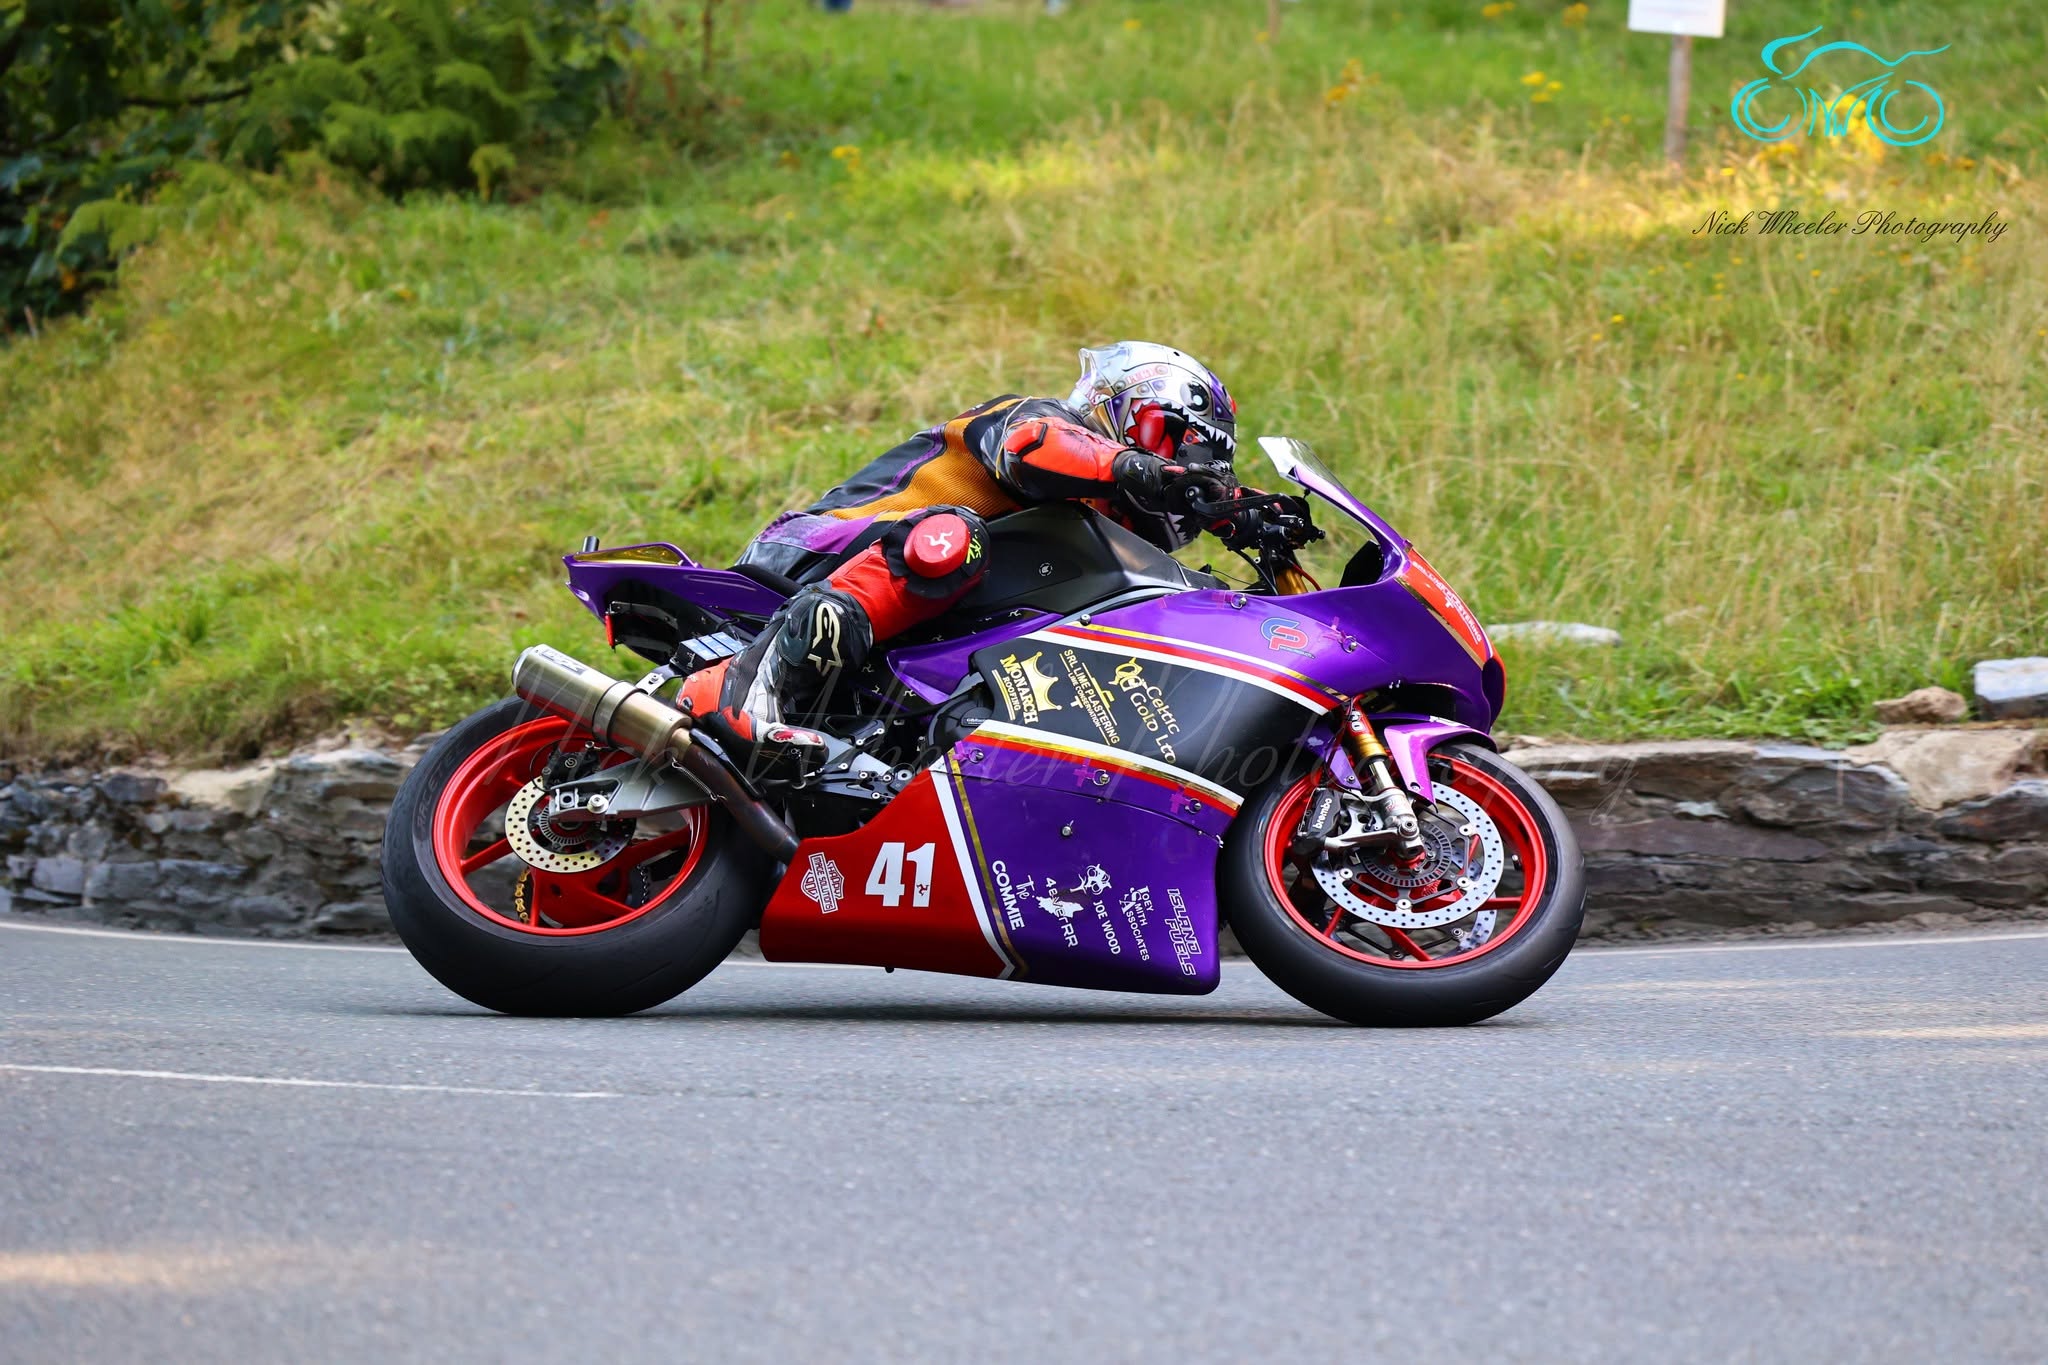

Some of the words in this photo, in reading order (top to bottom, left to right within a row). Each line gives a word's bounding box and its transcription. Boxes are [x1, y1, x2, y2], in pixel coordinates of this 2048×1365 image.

[1000, 653, 1039, 724] MONARCH
[1003, 676, 1021, 711] ROOFING
[1064, 649, 1078, 668] SRL
[1073, 667, 1091, 690] LIME
[1085, 689, 1120, 744] PLASTERING
[1068, 673, 1078, 687] LIME
[1076, 685, 1101, 728] CONSERVATION
[1146, 686, 1180, 734] Celtic
[1312, 797, 1333, 829] brembo
[813, 856, 825, 875] IMAGE
[818, 876, 833, 909] SOLUTIONS
[865, 842, 936, 907] 41
[1016, 875, 1035, 899] The
[992, 860, 1025, 931] COMMIE
[1130, 887, 1148, 926] SMITH
[1137, 886, 1154, 911] JOEY
[1167, 888, 1201, 955] ISLAND
[1093, 900, 1108, 919] JOE
[1101, 920, 1120, 954] WOOD
[1119, 898, 1150, 961] ASSOCIATES
[1165, 919, 1196, 975] FUELS
